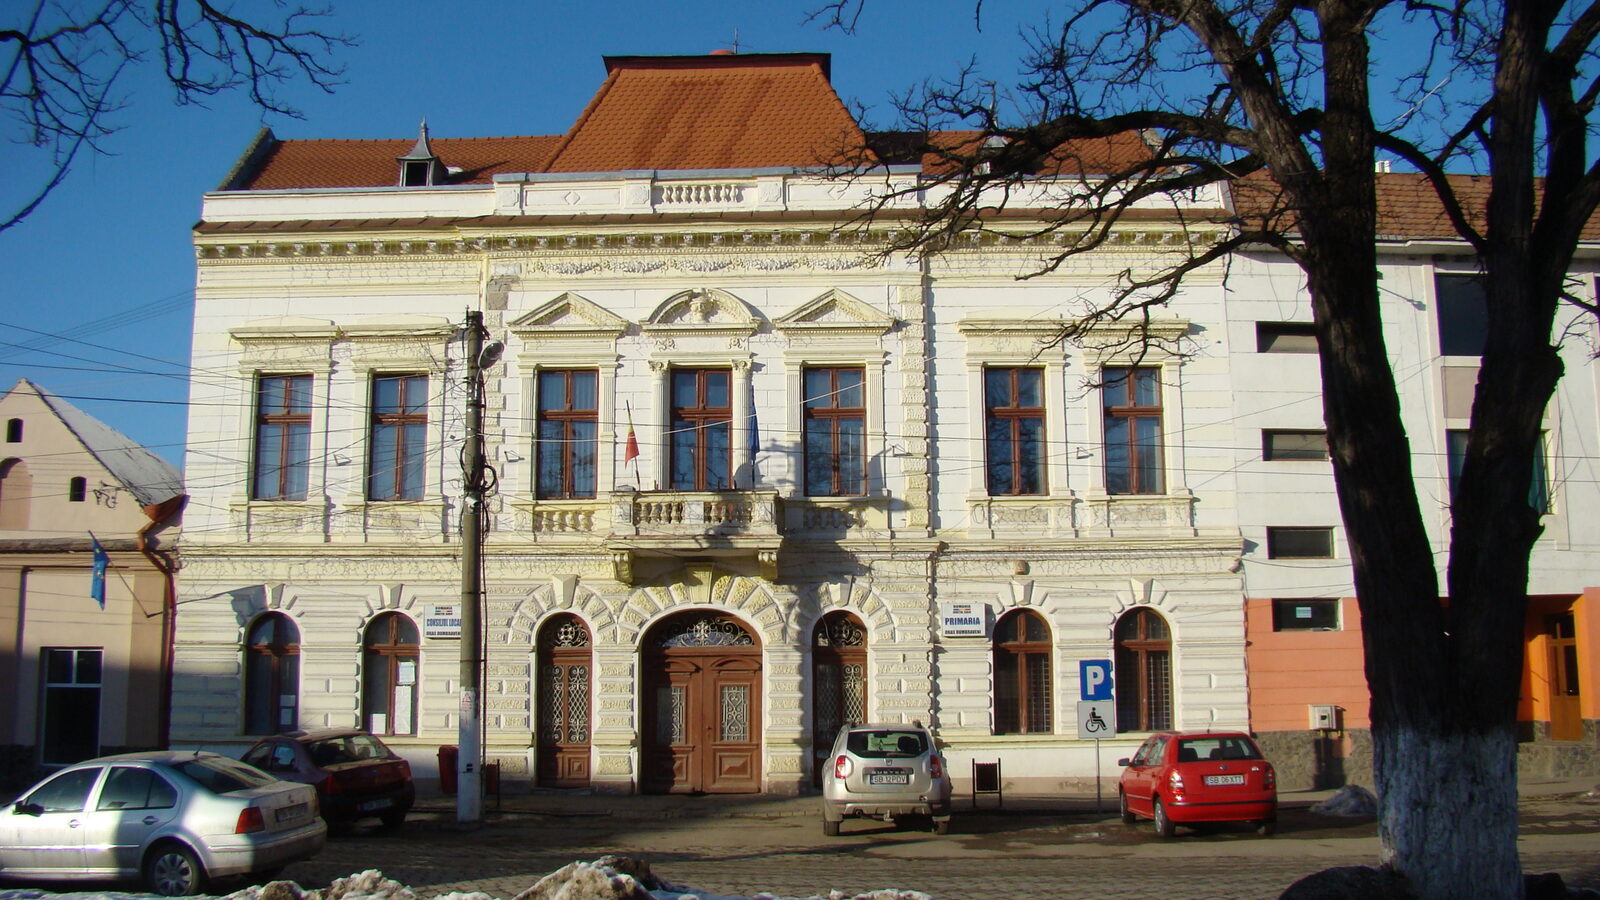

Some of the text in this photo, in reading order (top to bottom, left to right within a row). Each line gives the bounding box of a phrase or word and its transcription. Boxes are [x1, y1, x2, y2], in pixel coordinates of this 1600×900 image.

[945, 617, 980, 625] PRIMARIA
[1086, 665, 1105, 695] P
[874, 775, 884, 783] SB
